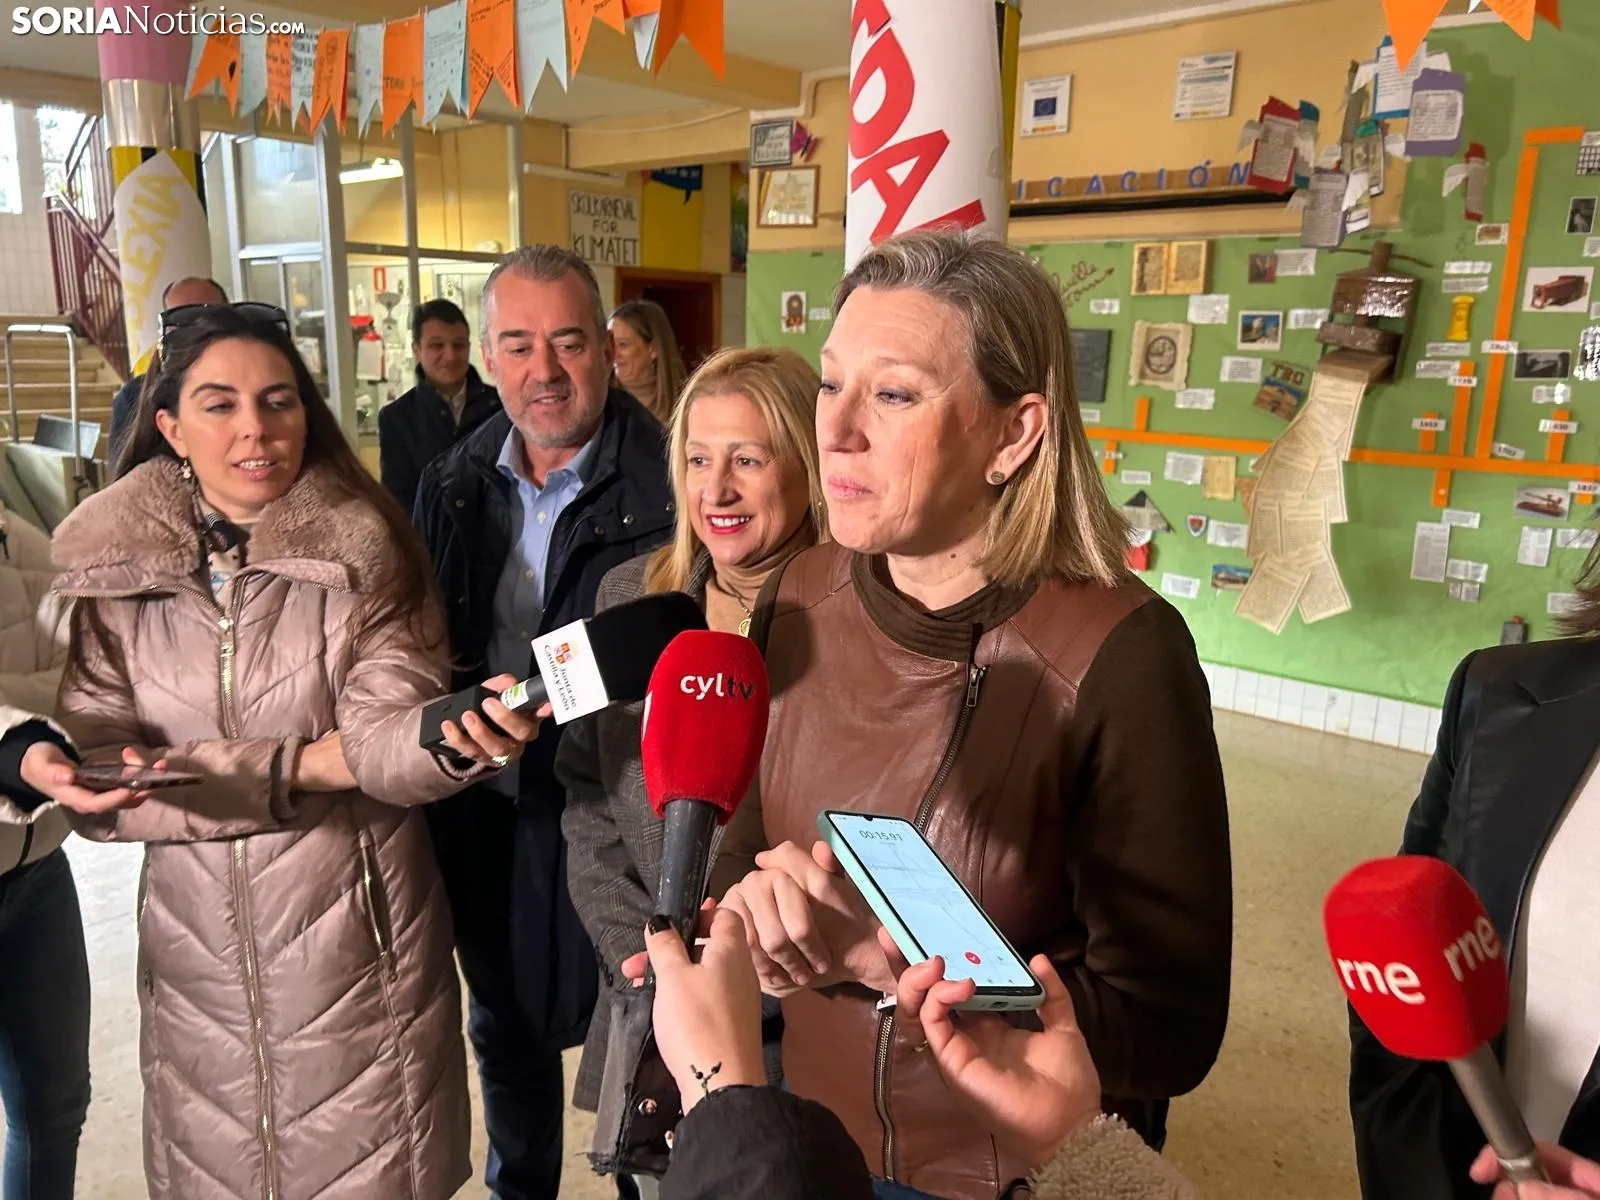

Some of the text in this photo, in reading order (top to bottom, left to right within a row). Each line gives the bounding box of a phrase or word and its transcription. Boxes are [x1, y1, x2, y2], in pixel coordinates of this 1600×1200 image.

[560, 667, 572, 693] Junta
[1443, 915, 1500, 982] rne
[1337, 957, 1426, 1005] rne
